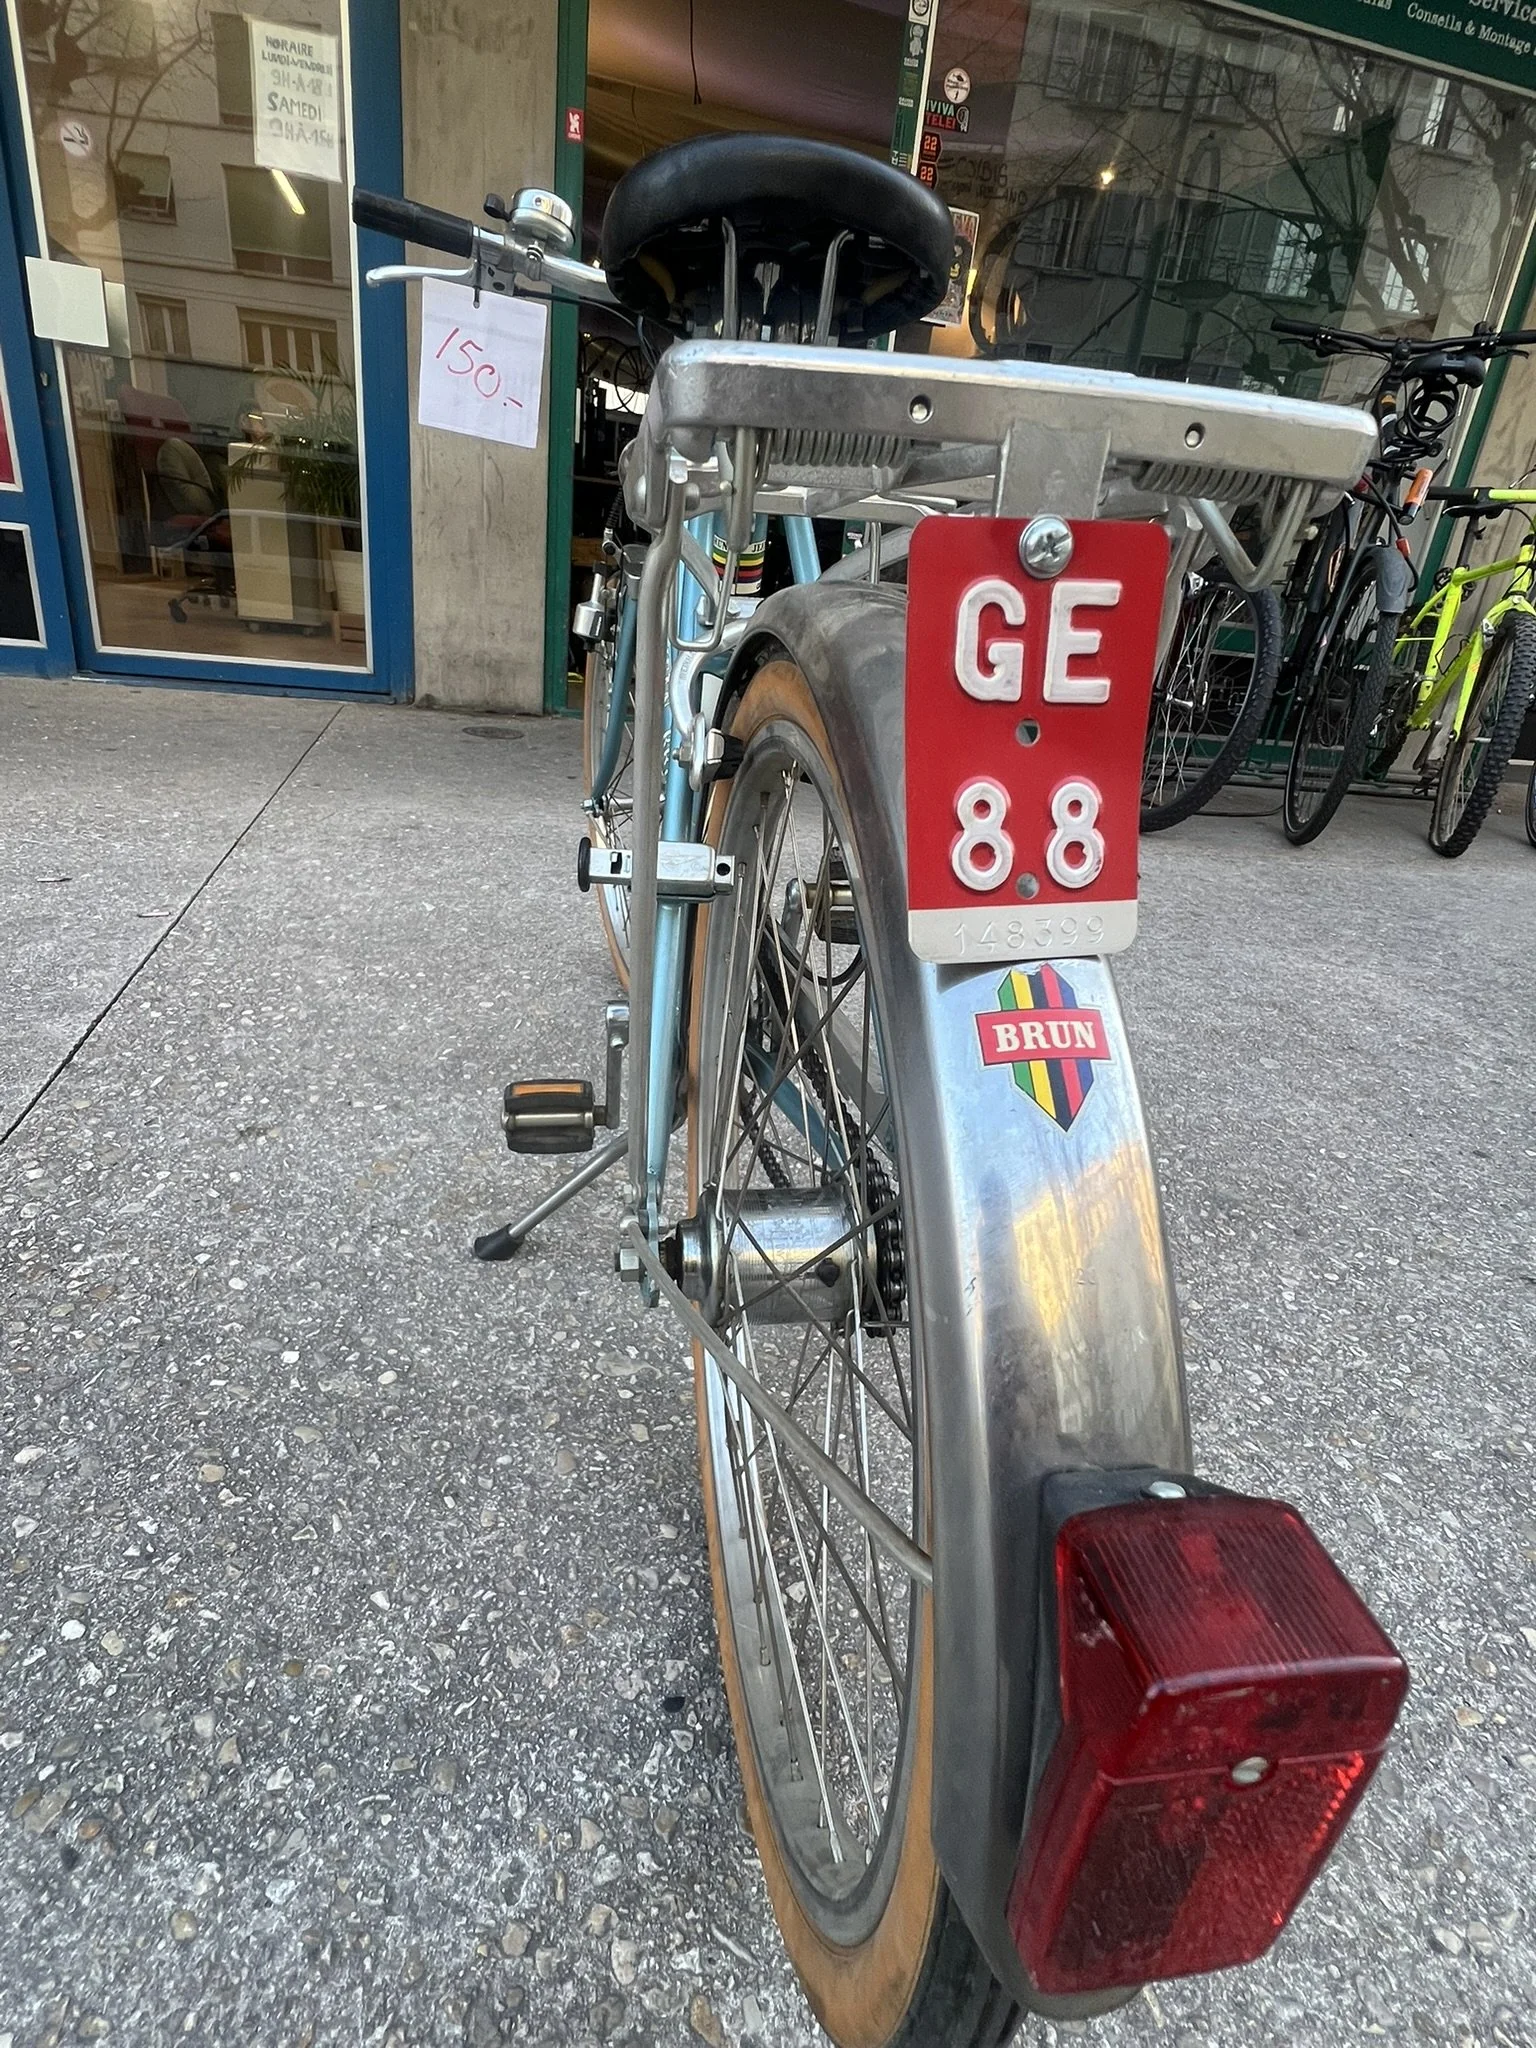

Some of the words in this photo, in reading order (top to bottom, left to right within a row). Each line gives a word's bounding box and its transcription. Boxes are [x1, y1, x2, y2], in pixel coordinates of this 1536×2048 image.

[265, 35, 313, 58] HORAIRE
[1406, 2, 1462, 33] Conseils
[1464, 20, 1476, 36] &
[1478, 24, 1531, 56] Montage
[266, 91, 322, 122] SAMEDI
[924, 135, 938, 151] 22
[920, 166, 934, 182] 22
[435, 328, 523, 408] 150.-
[954, 578, 1122, 705] GE
[951, 775, 1105, 891] 88
[953, 914, 1107, 957] 148399
[992, 1021, 1096, 1053] BRUN
